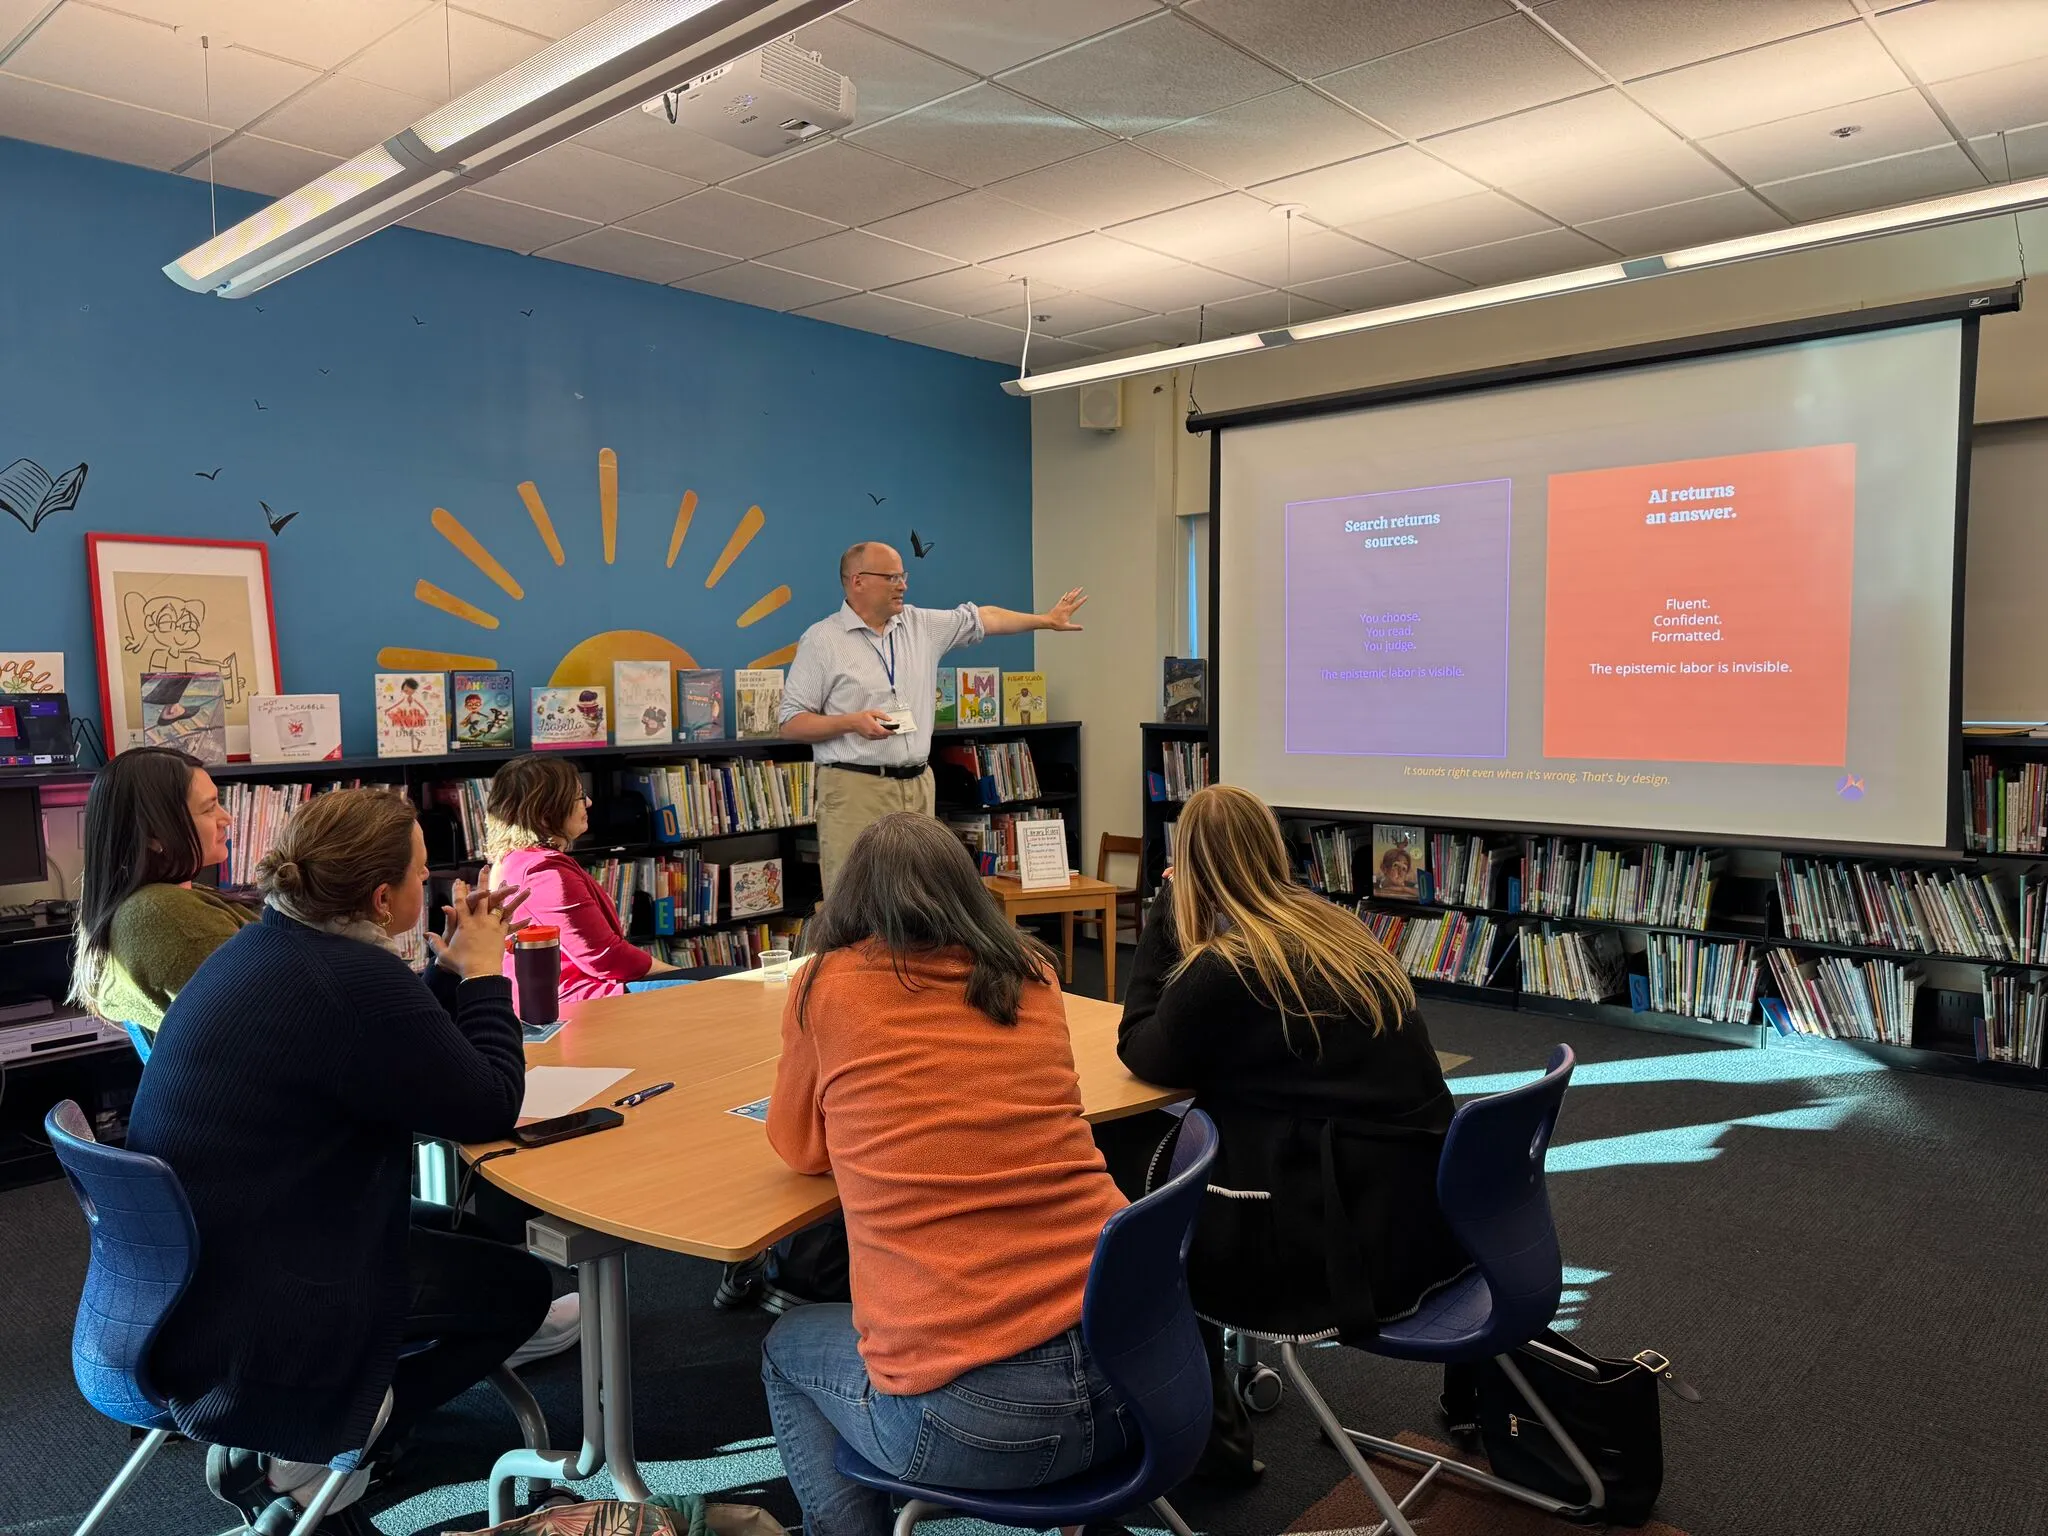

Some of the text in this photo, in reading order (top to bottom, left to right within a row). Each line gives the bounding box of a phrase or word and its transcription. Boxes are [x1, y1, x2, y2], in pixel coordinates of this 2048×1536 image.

[1648, 485, 1735, 504] AI returns
[1344, 513, 1440, 533] Search returns
[1646, 506, 1737, 524] an answer.
[1364, 534, 1418, 549] sources.
[1666, 599, 1710, 610] Fluent.
[1360, 612, 1421, 624] You choose.
[1653, 614, 1722, 626] Confident.
[1366, 625, 1414, 637] You read.
[1651, 630, 1724, 642] Formatted.
[1364, 639, 1416, 653] You judge.
[0, 660, 54, 694] able
[1320, 665, 1465, 681] The epistemic labor is visible.
[1590, 661, 1793, 677] The epistemic labor is invisible.
[538, 718, 585, 733] Isabella
[1403, 766, 1671, 786] It sounds right even when it's wrong. That's by design.
[662, 809, 676, 836] D
[658, 901, 669, 929] E
